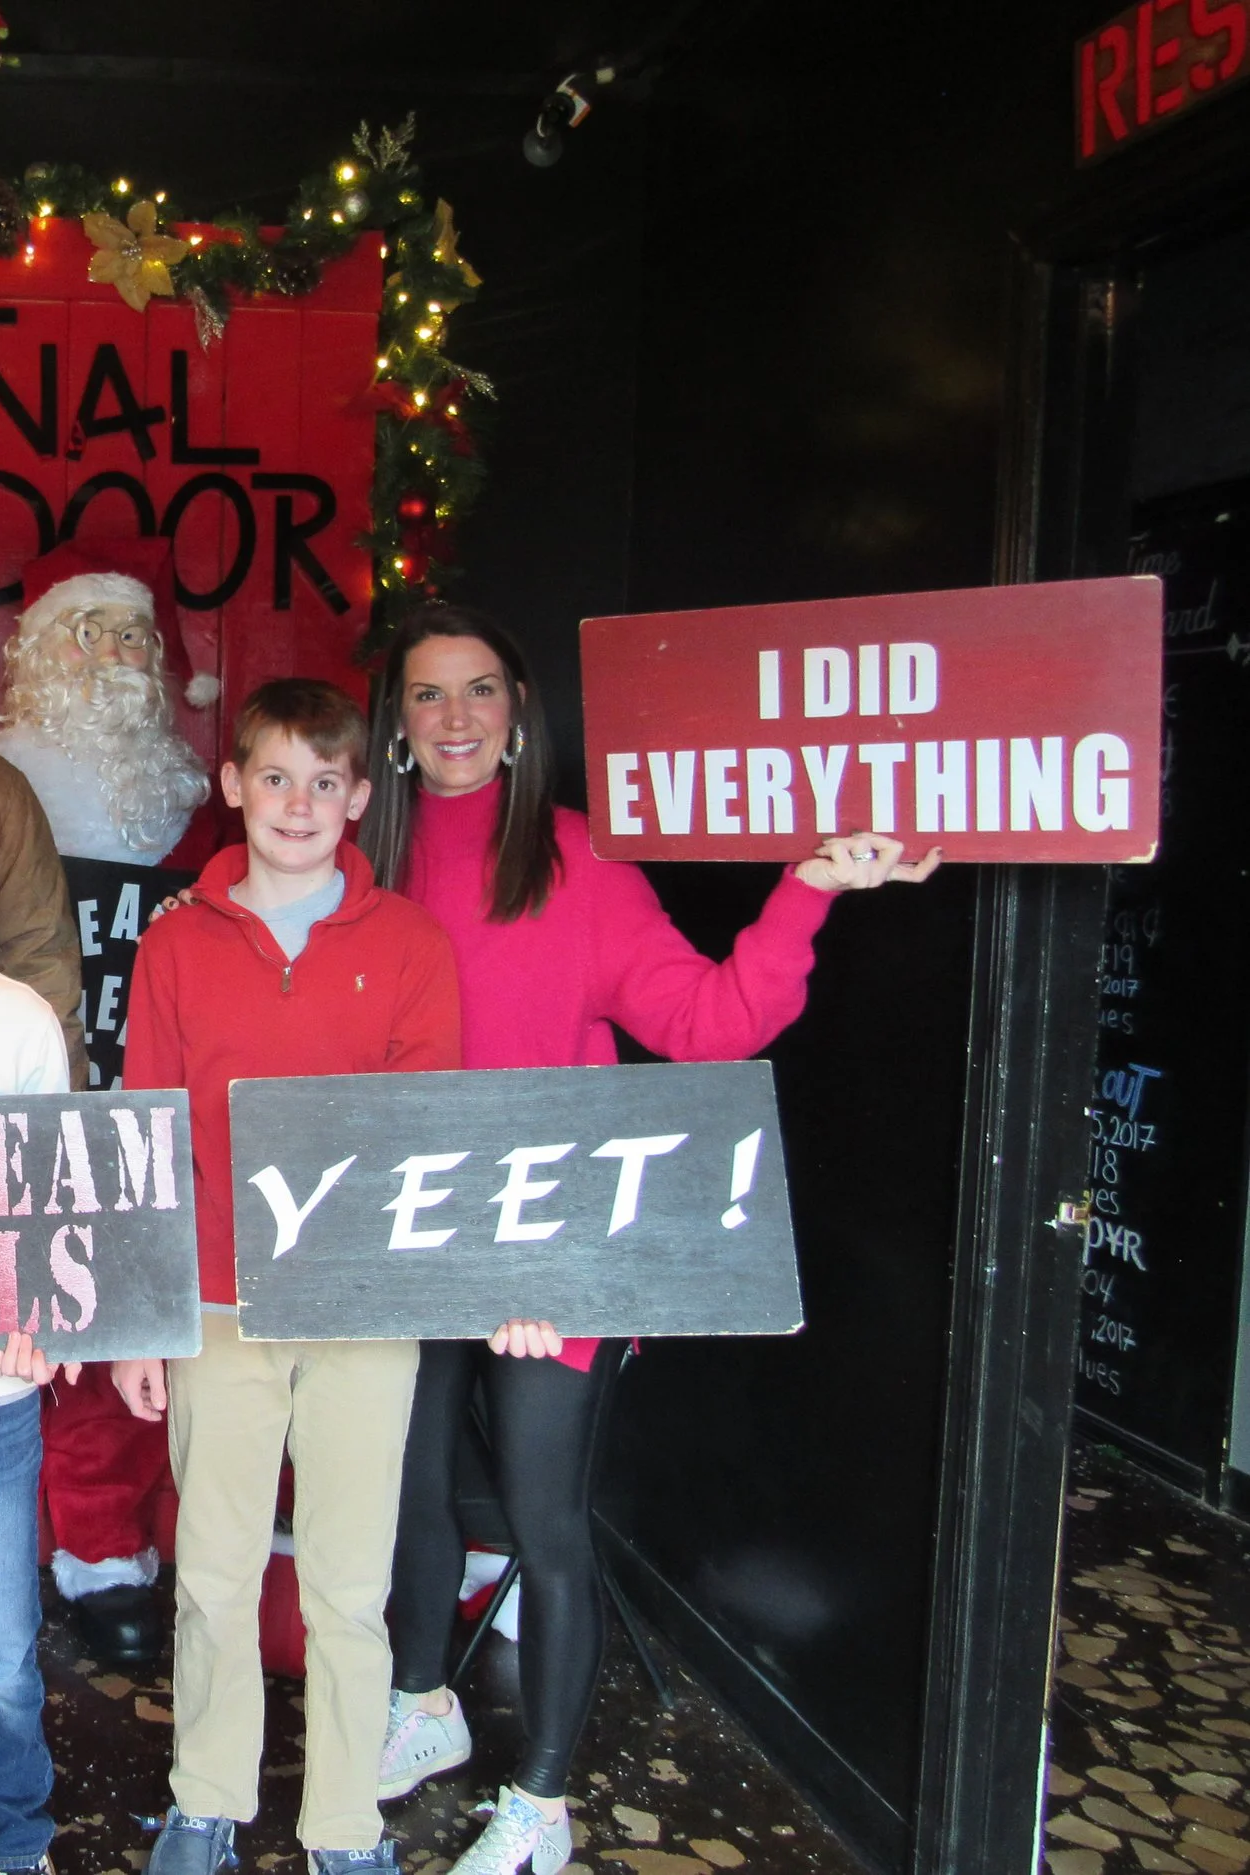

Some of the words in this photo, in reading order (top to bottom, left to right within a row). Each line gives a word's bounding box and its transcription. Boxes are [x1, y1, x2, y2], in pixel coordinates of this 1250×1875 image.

[758, 650, 780, 720] I
[803, 642, 938, 718] DID
[606, 732, 1131, 836] EVERYTHING
